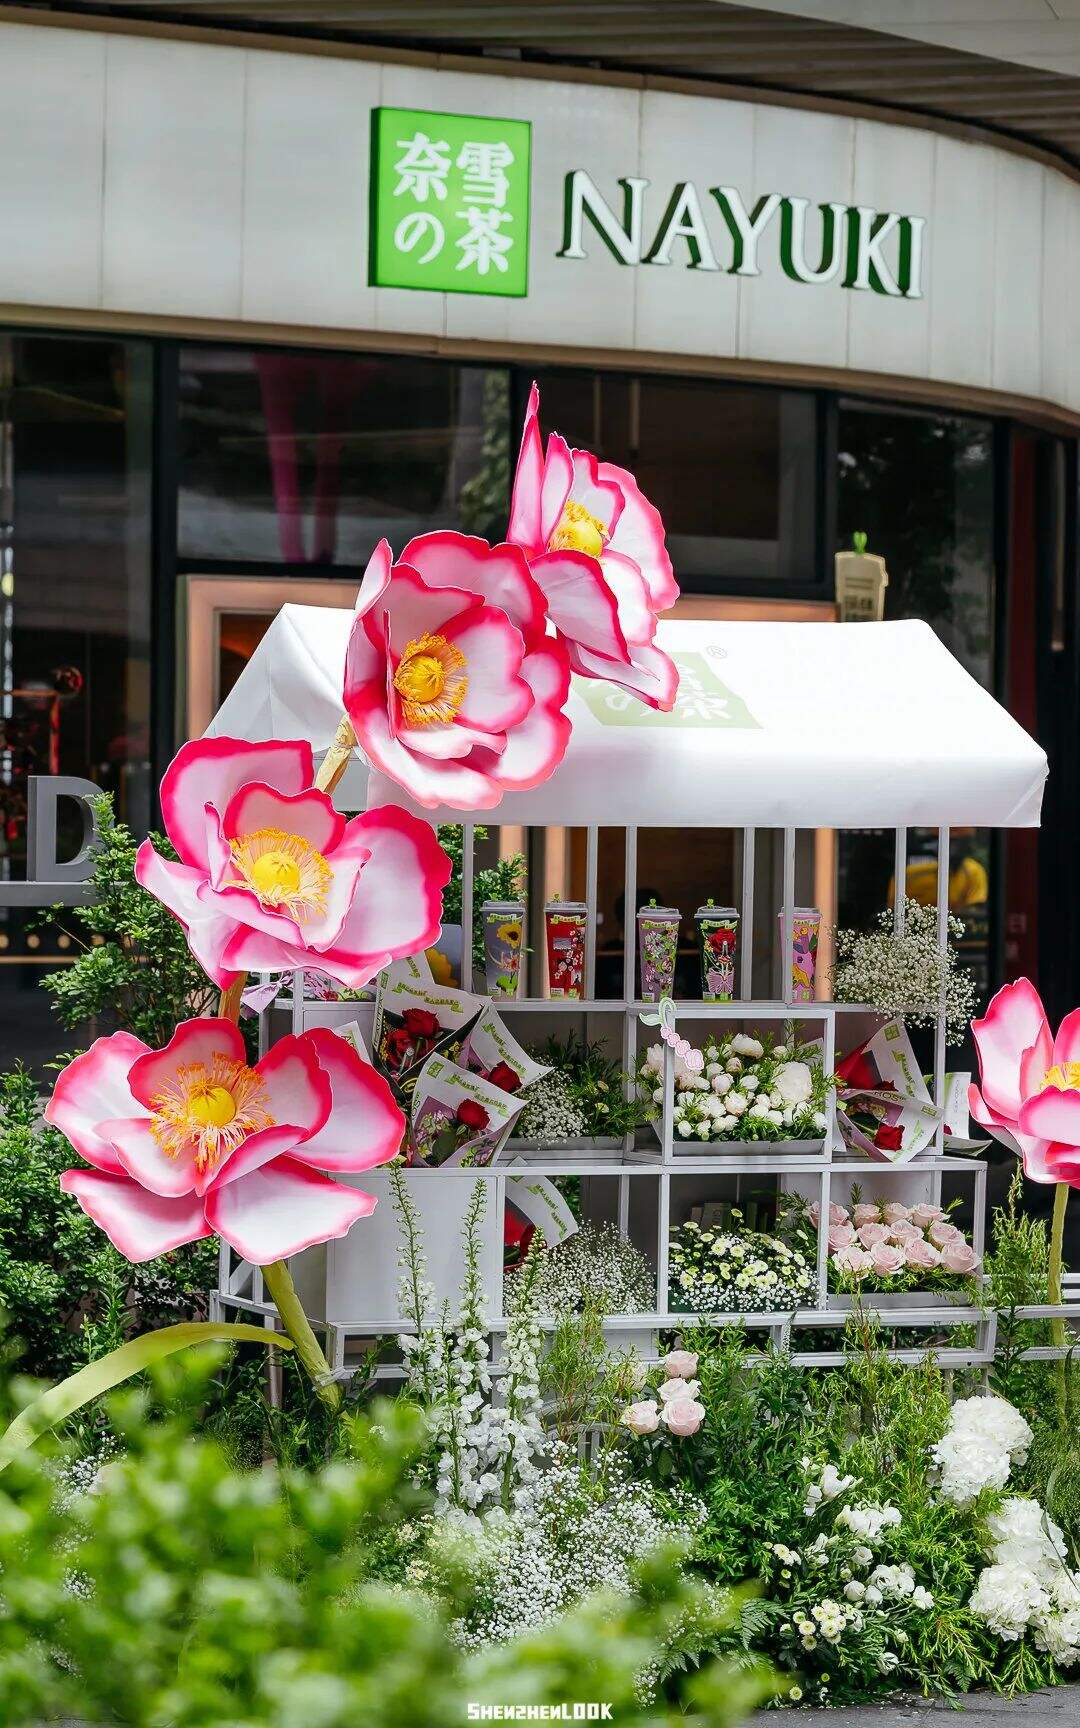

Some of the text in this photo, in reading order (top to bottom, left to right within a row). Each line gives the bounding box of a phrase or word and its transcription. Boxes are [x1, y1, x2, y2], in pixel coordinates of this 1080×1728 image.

[392, 132, 515, 209] 奈雪
[393, 206, 514, 275] の茶
[556, 168, 927, 299] NAYUKI
